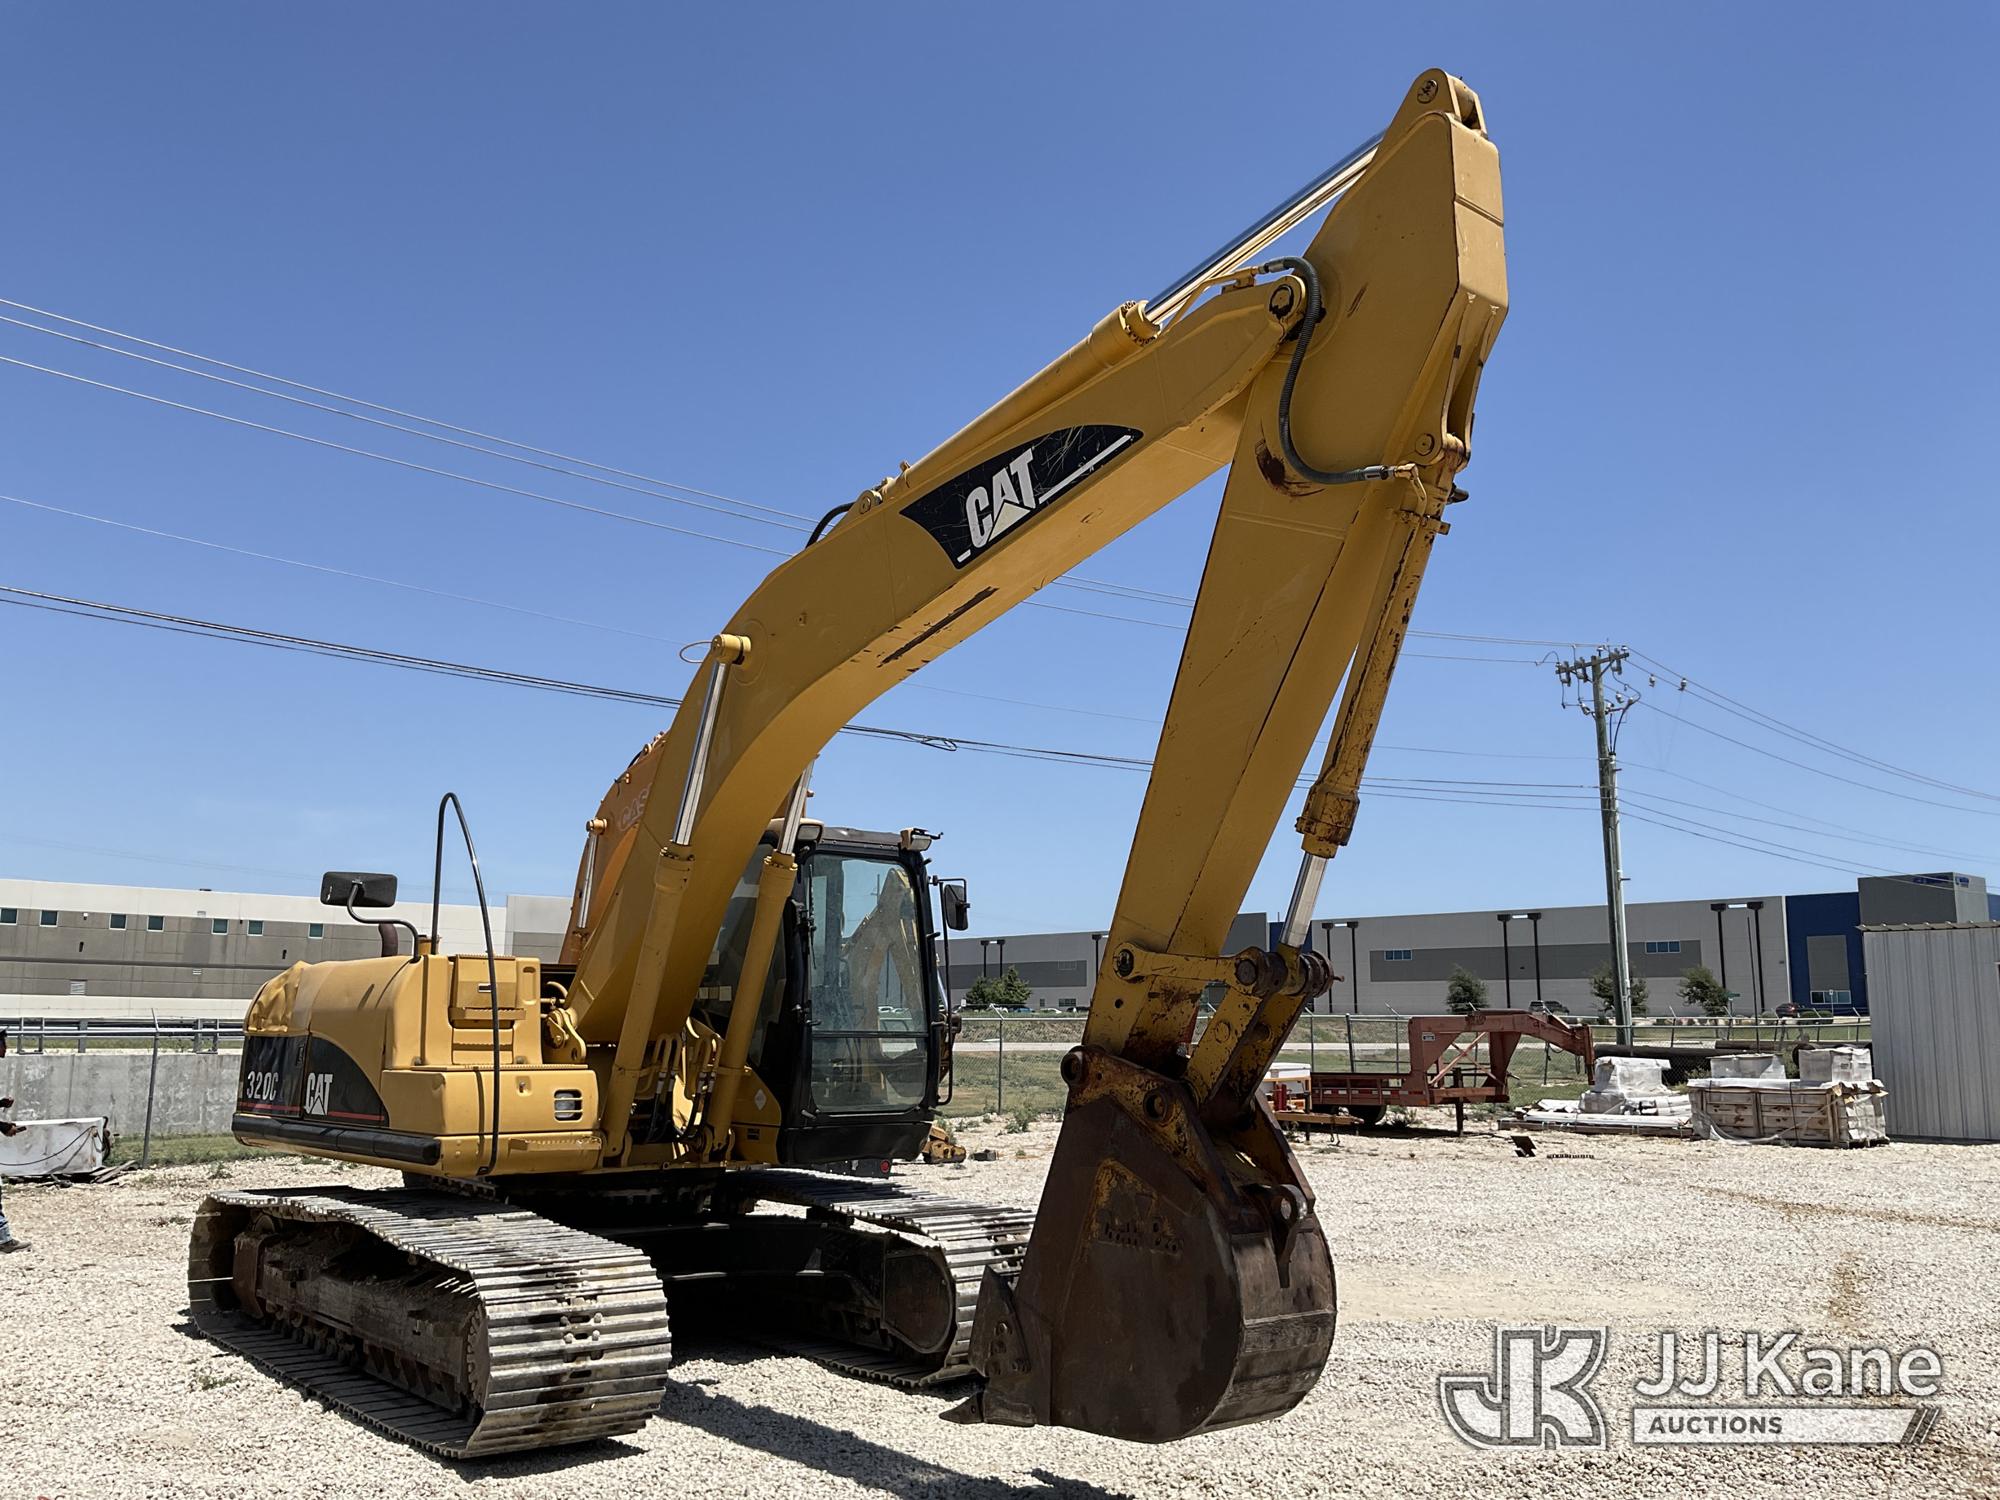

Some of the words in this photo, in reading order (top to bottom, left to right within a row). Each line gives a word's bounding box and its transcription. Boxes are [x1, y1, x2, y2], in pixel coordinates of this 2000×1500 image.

[965, 448, 1036, 548] CAT
[247, 1071, 279, 1101] 320C
[304, 1072, 333, 1115] CAT
